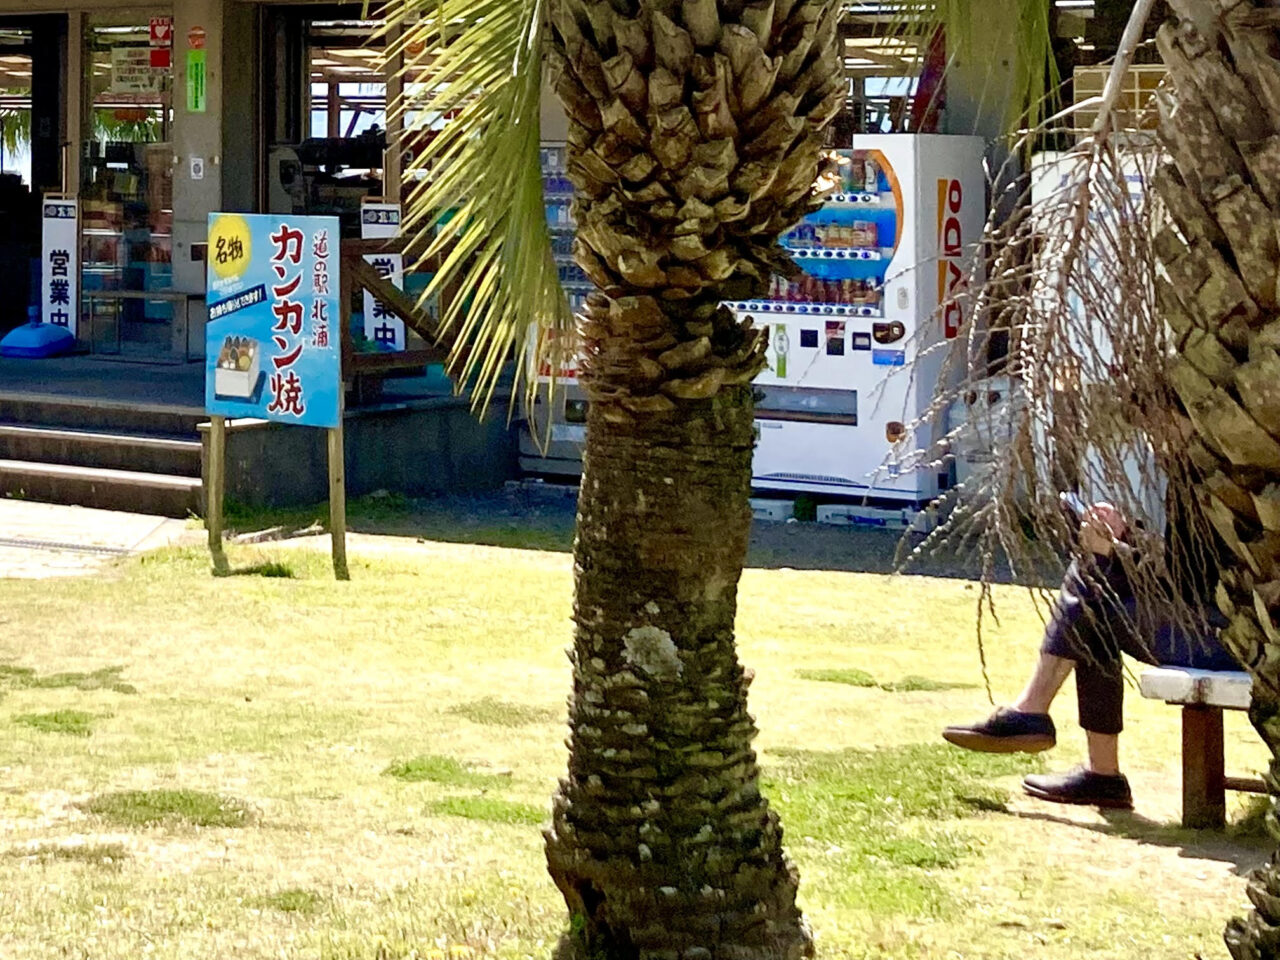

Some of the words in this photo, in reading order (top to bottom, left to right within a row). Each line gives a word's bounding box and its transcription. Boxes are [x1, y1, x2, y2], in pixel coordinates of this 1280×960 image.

[49, 249, 70, 328] 営業中
[215, 237, 244, 264] 名物
[269, 224, 305, 417] カンカン焼
